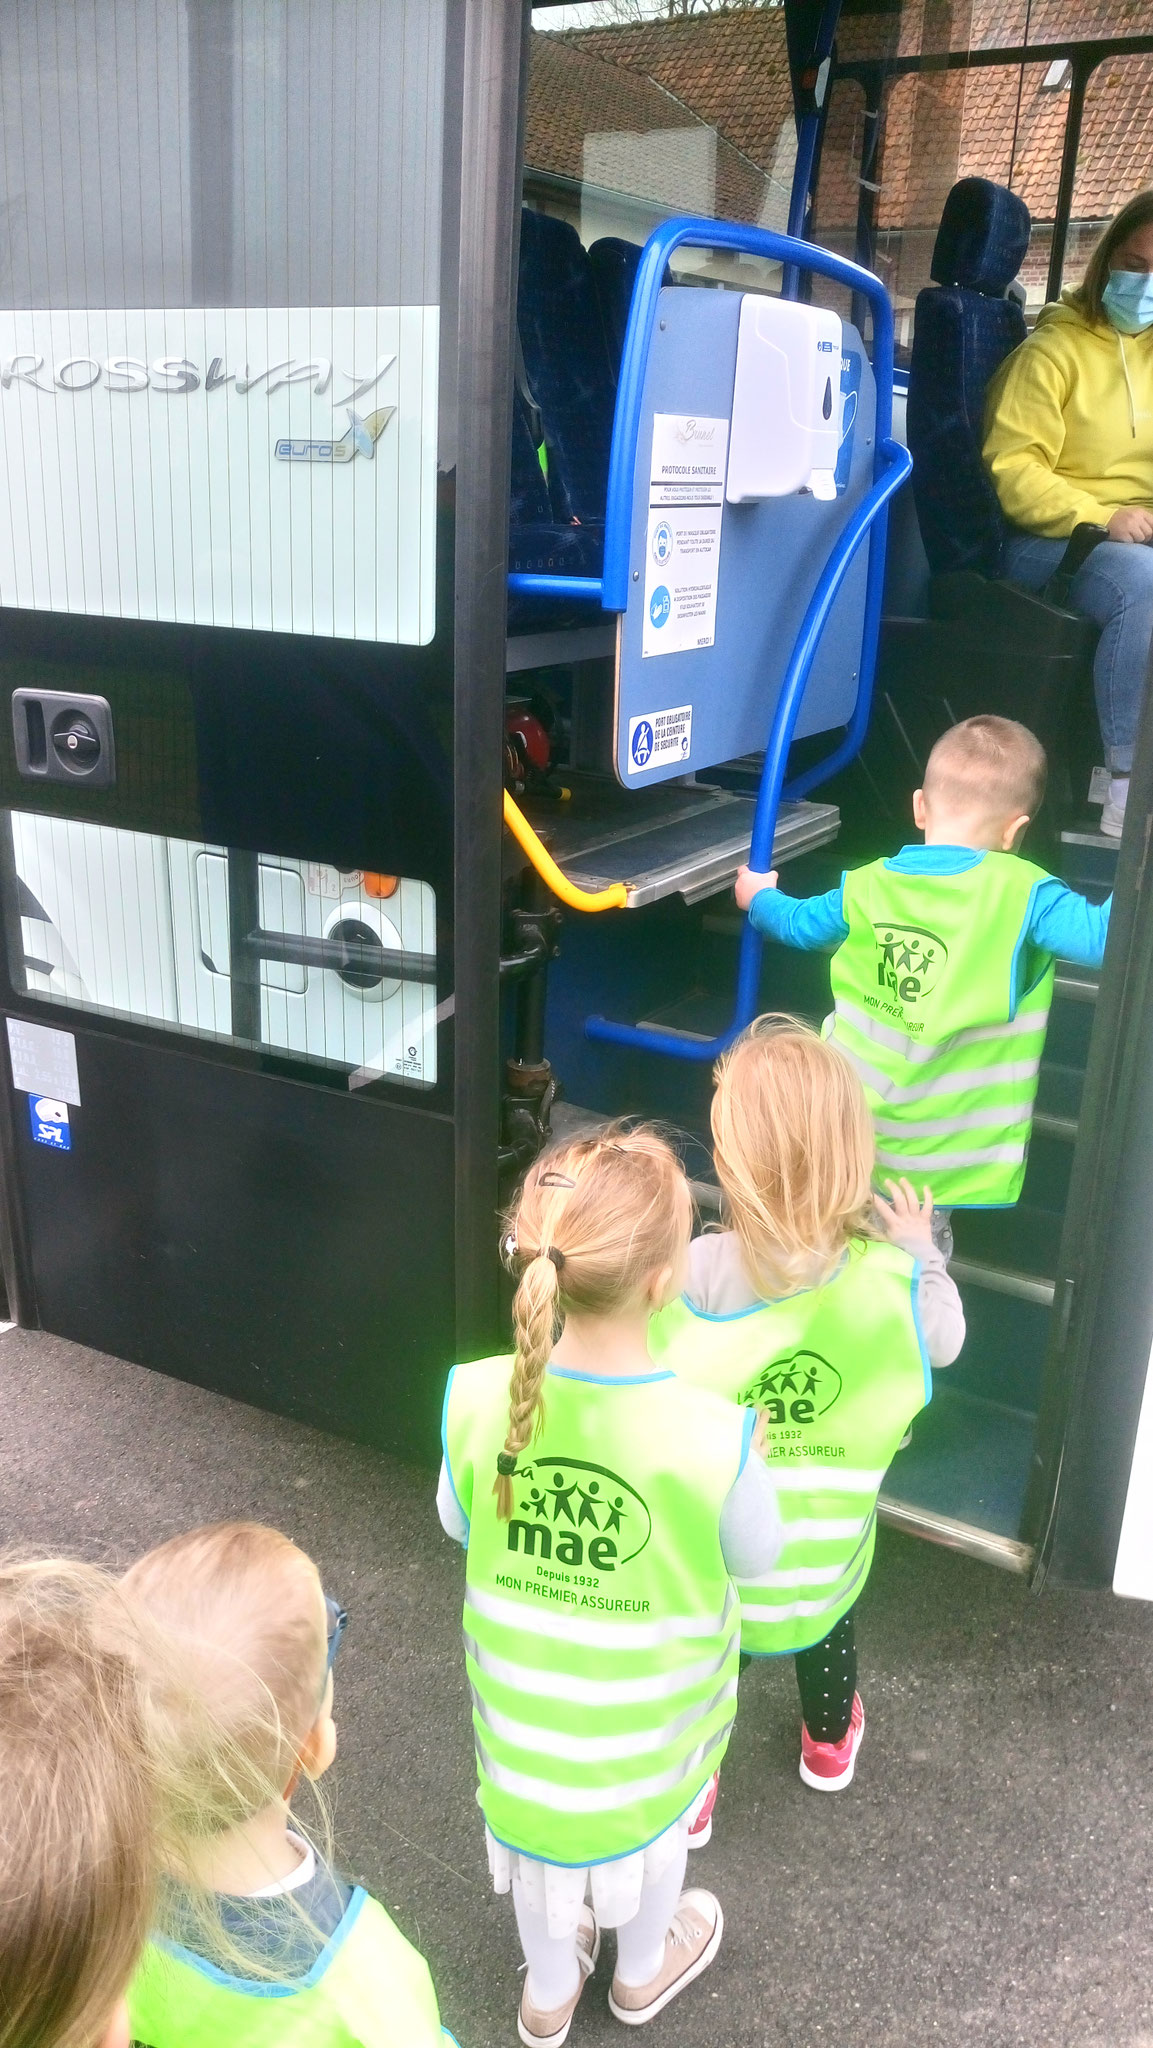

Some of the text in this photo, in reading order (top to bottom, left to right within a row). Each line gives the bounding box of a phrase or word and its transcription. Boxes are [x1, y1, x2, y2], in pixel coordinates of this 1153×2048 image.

[661, 465, 717, 475] PROTOCOLE SANITAIRE
[655, 711, 691, 728] PORT OBLIGATOIRE
[655, 724, 686, 740] DE LA CEINTURE
[654, 742, 660, 752] DE
[863, 994, 880, 1009] MON
[38, 1123, 64, 1143] SPL
[763, 1398, 815, 1424] ae
[780, 1430, 802, 1440] 1932
[788, 1446, 846, 1458] ASSUREUR
[508, 1519, 618, 1572] mae
[536, 1566, 600, 1588] Depuis 1932
[496, 1574, 650, 1612] MON PREMIER ASSUREUR
